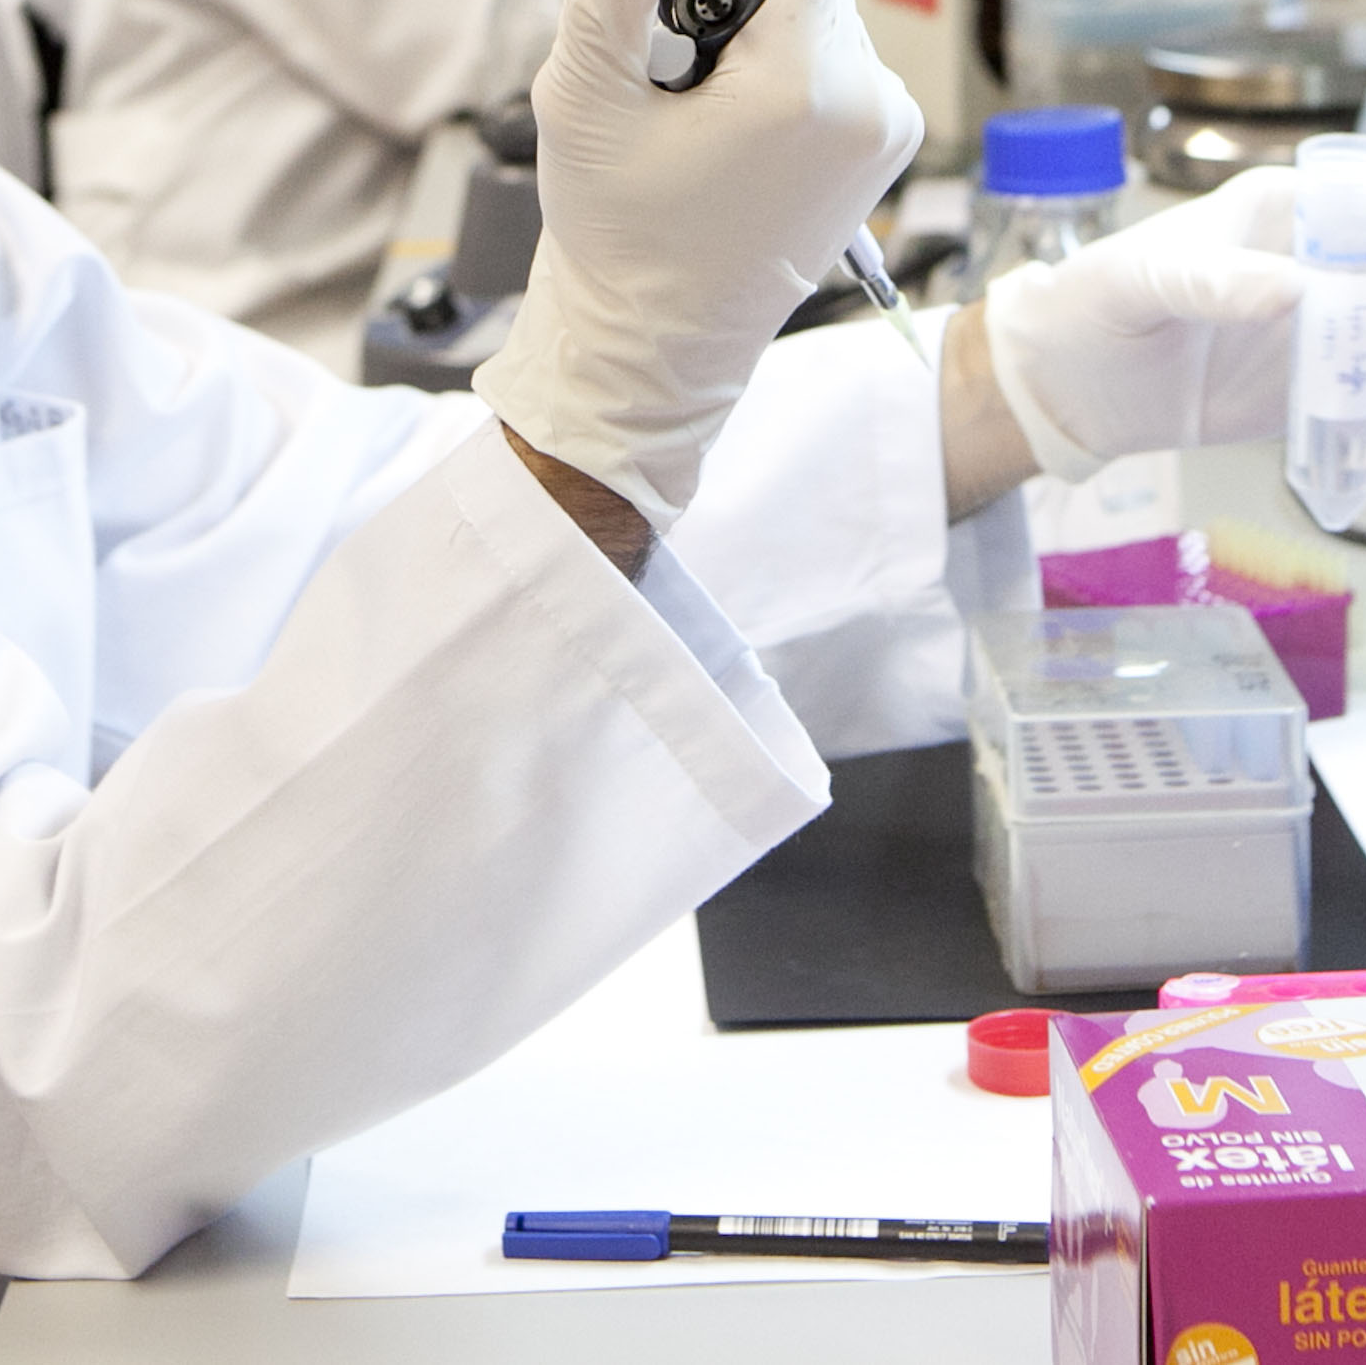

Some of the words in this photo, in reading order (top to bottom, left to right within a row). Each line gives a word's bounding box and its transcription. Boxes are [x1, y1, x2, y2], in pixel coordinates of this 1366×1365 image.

[1165, 1074, 1292, 1116] M
[1160, 1131, 1265, 1150] POLVO
[1272, 1130, 1324, 1145] SIN
[1179, 1174, 1214, 1190] de
[1220, 1171, 1333, 1185] Guantes
[1294, 1330, 1331, 1352] SIN
